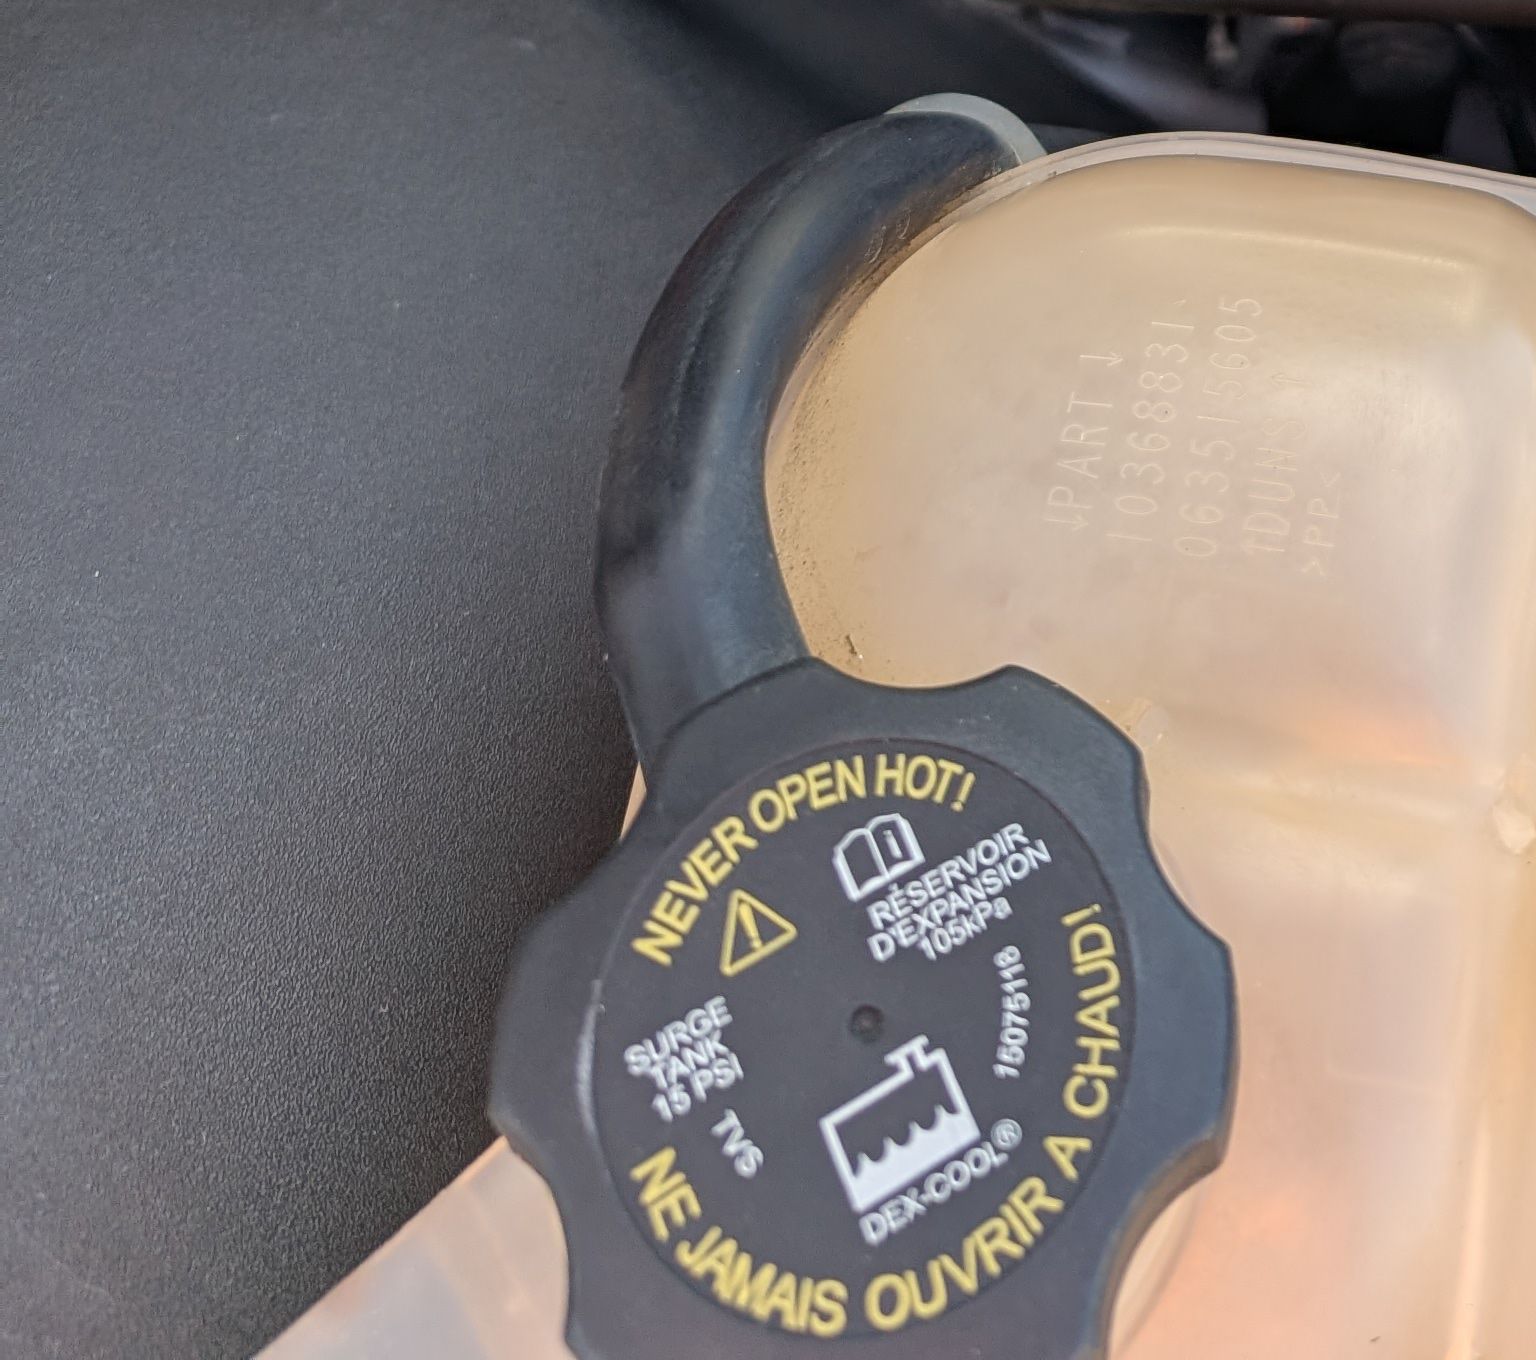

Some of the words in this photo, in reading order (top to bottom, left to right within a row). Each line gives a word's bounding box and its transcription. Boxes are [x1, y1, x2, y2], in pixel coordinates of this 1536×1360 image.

[1047, 391, 1114, 509] PART
[1105, 320, 1196, 542] 10368831
[1173, 297, 1264, 557] 063515605
[1243, 416, 1306, 536] DUNS
[631, 815, 759, 966] NEVER
[748, 754, 866, 833] OPEN
[874, 753, 976, 812] HOT!
[866, 823, 1030, 930] RÉSERVOIR
[866, 838, 1052, 962] D'EXPANSION
[623, 995, 733, 1076] SURGE
[647, 1028, 728, 1092] TANK
[1060, 903, 1122, 1119] CHAUD!
[651, 1082, 692, 1122] 15
[690, 1051, 745, 1102] PSI
[710, 1108, 765, 1178] TVS
[630, 1146, 702, 1242] NE
[1043, 1135, 1093, 1180] A
[674, 1226, 849, 1339] JAMAIS
[864, 1176, 1065, 1332] OUVRIR
